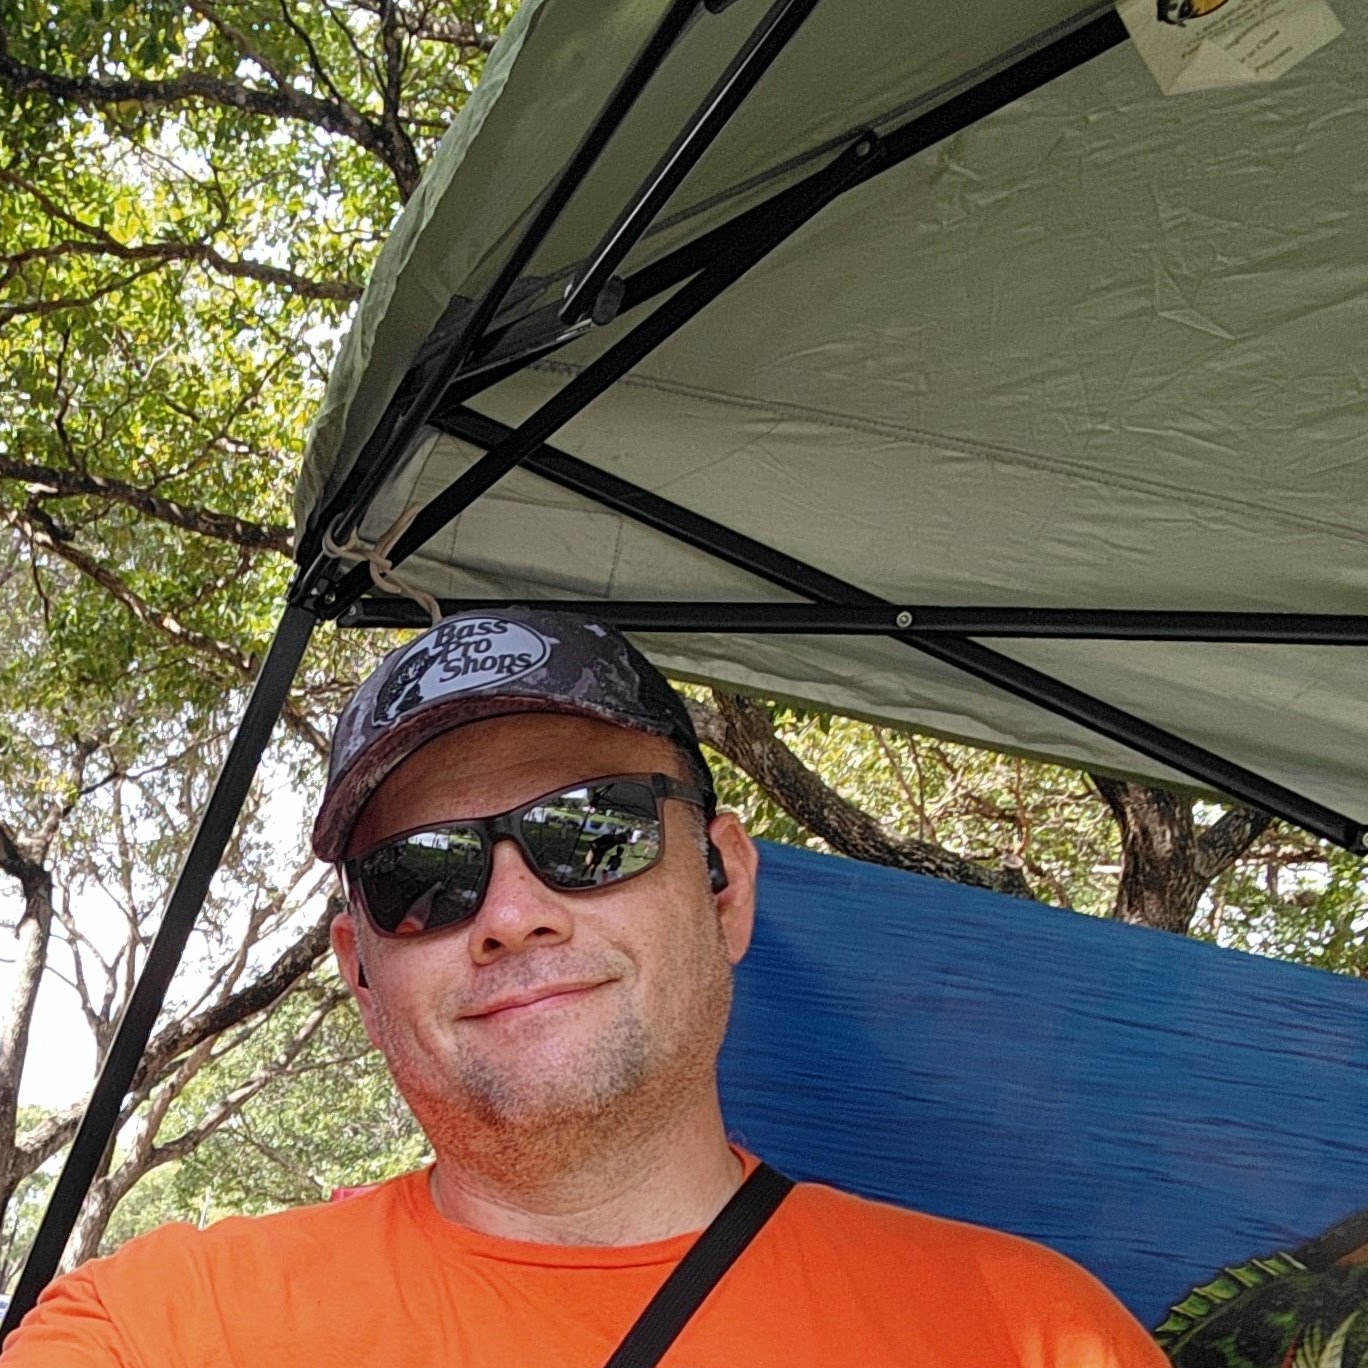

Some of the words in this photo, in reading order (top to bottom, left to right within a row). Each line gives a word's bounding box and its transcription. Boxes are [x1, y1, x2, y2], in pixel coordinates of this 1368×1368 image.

[432, 621, 508, 649] Bass
[438, 638, 492, 664] Pro
[439, 653, 532, 683] Shops
